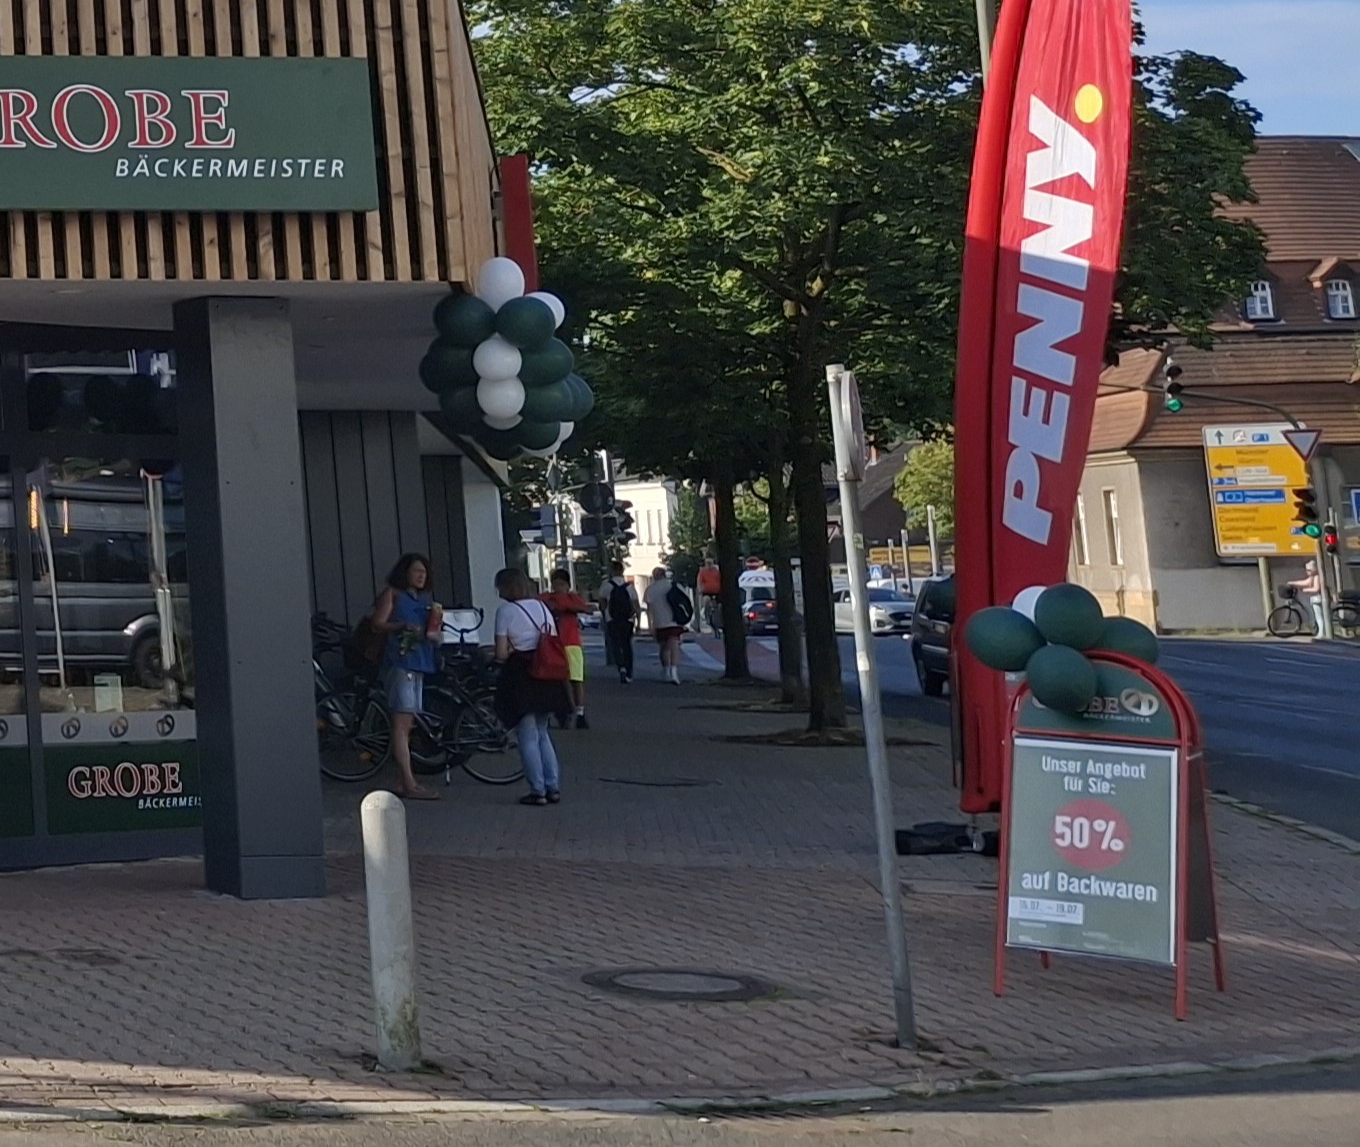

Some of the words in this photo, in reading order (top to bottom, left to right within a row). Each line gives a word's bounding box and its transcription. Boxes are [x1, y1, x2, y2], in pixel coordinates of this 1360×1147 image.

[115, 154, 346, 179] BÄCKERMEISTER
[67, 762, 183, 799] GROBE
[1041, 755, 1082, 774] Unser
[1086, 758, 1147, 780] Angebot
[1064, 776, 1082, 792] für
[1054, 815, 1125, 852] 50%
[1021, 872, 1050, 891] auf
[1057, 872, 1158, 902] Backwaren
